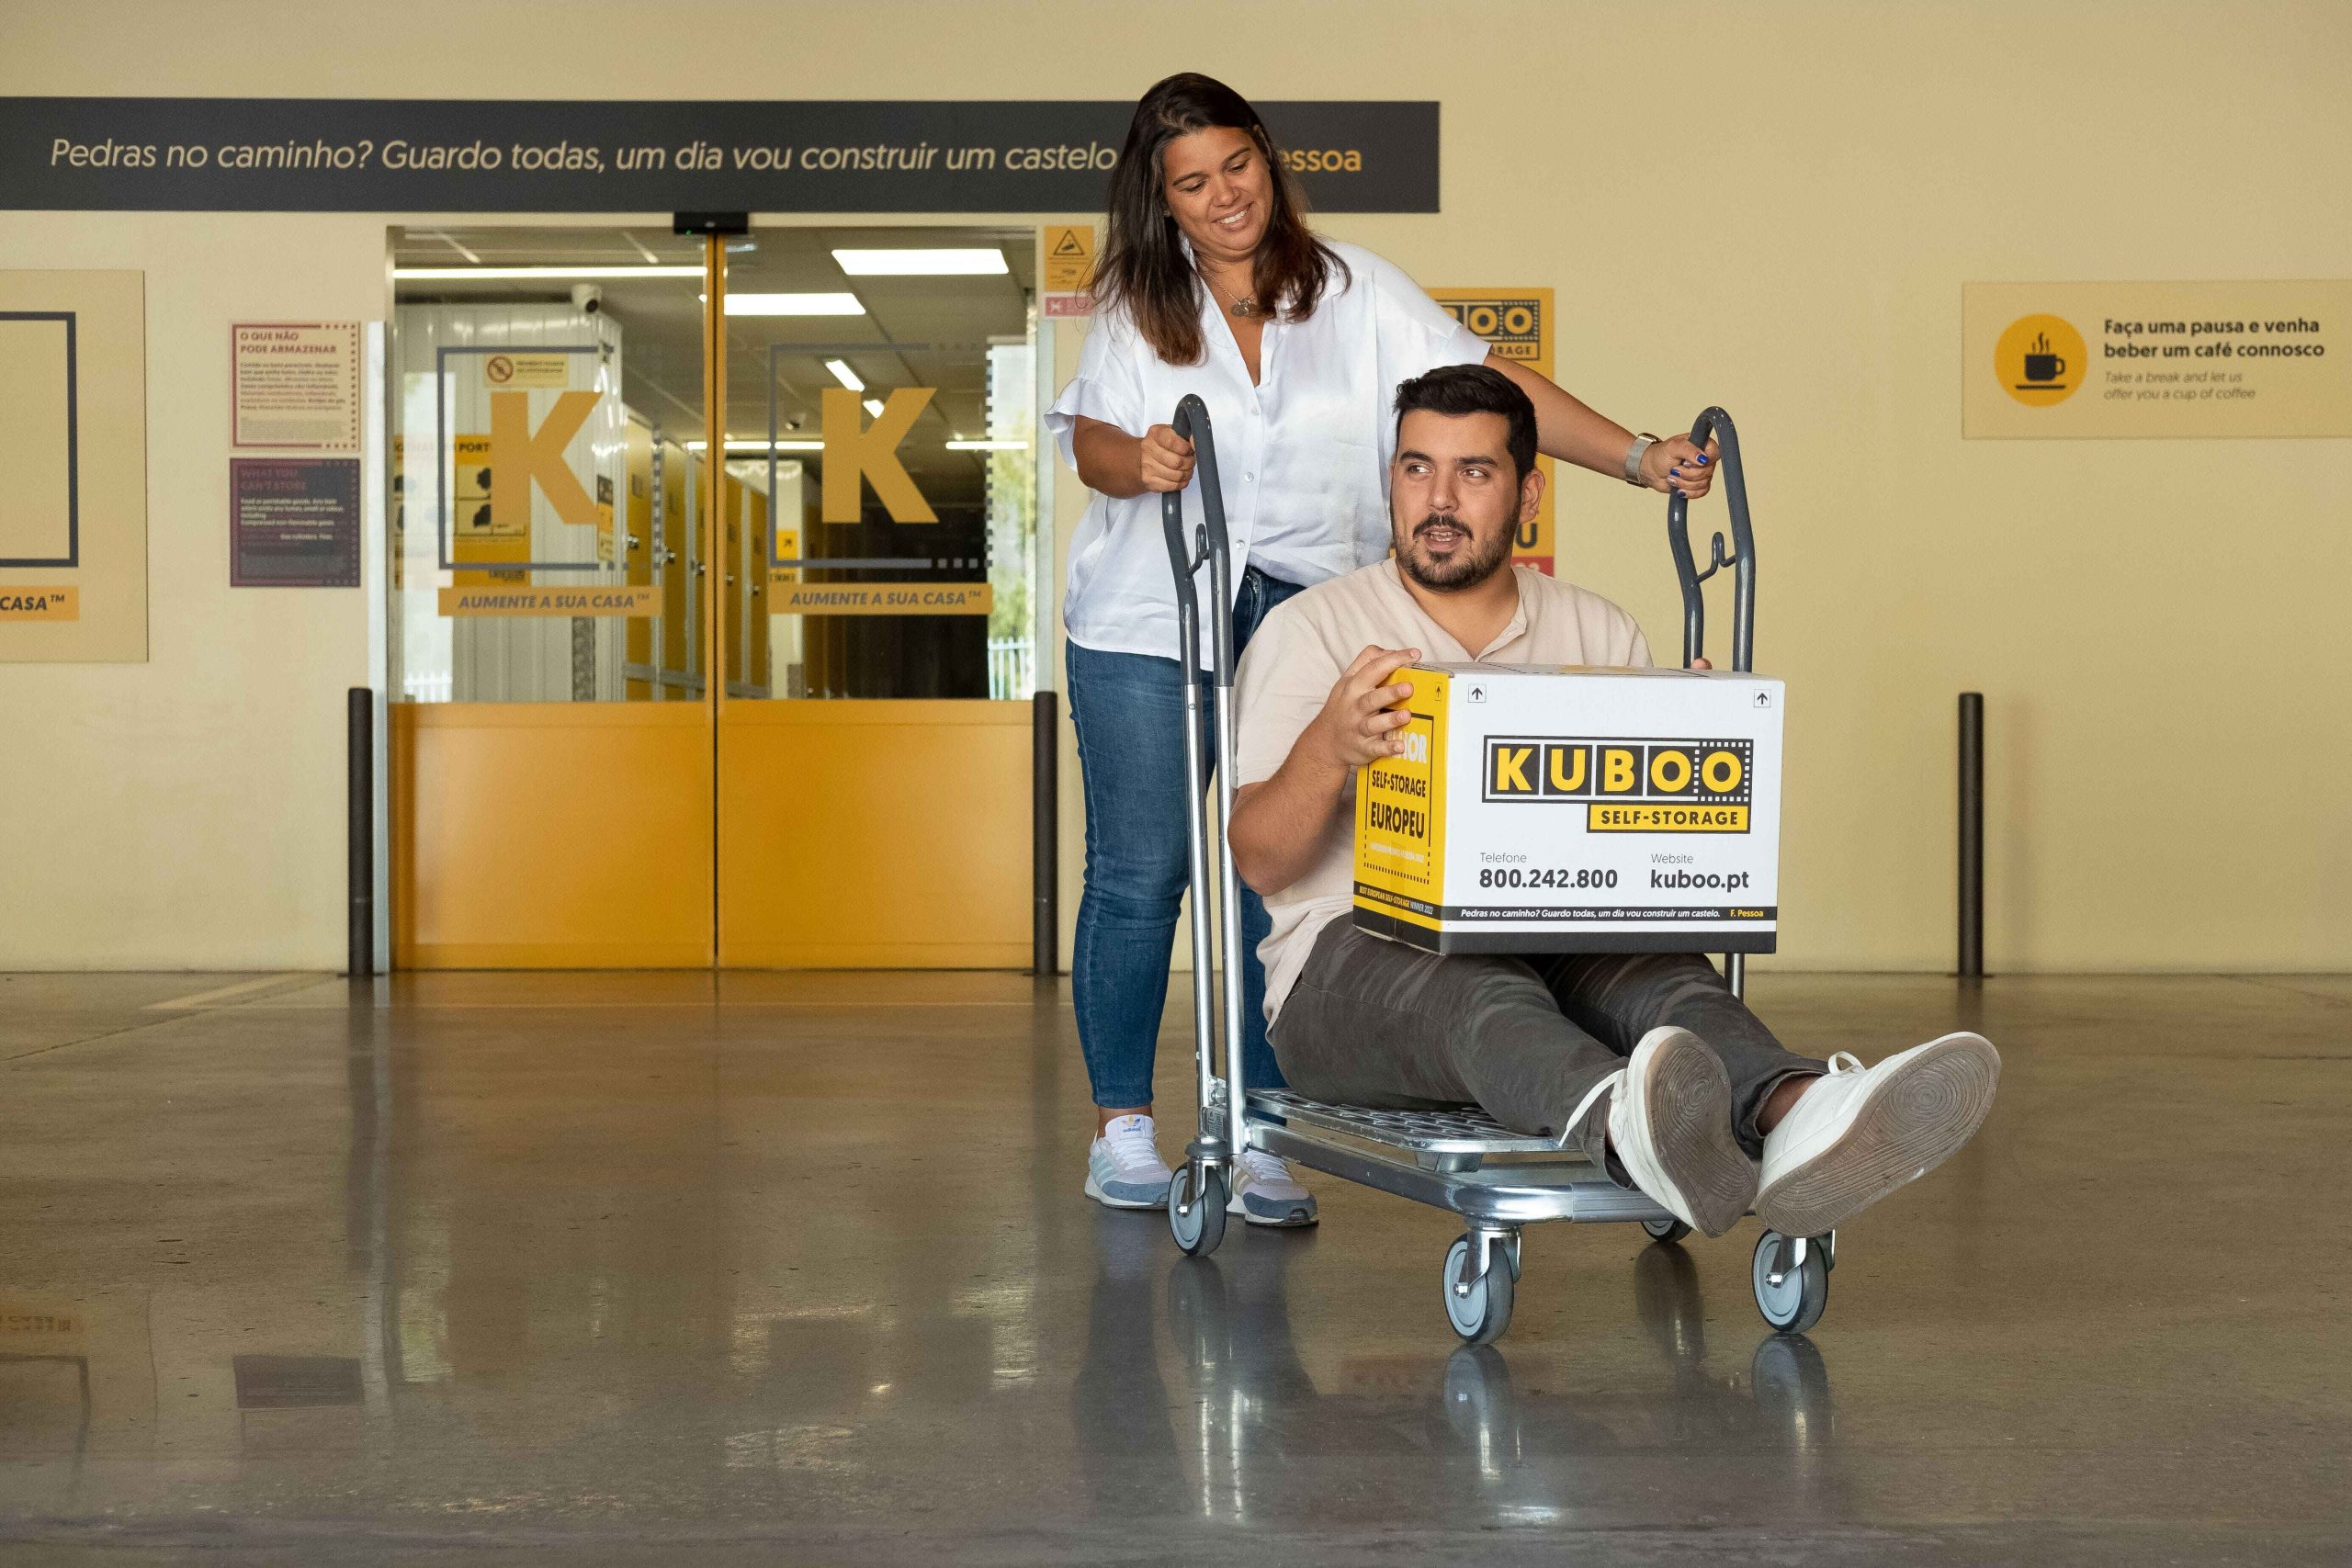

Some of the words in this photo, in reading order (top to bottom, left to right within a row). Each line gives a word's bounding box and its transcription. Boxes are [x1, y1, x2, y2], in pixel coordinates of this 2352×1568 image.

[51, 138, 157, 168] Pedras
[166, 145, 209, 169] no
[217, 140, 374, 170] caminho?
[381, 140, 503, 171] Guardo
[511, 141, 605, 175] todas,
[616, 145, 665, 171] um
[674, 141, 724, 171] dia
[733, 145, 791, 171] vou
[800, 141, 938, 171] construir
[945, 145, 996, 171] um
[1005, 142, 1117, 171] castelo
[2104, 320, 2143, 338] Faça
[2148, 321, 2186, 334] uma
[2190, 321, 2245, 337] pausa
[2249, 321, 2260, 333] e
[2265, 317, 2320, 333] venha
[240, 332, 249, 341] O
[251, 332, 273, 342] QUE
[2104, 342, 2157, 358] beber
[2163, 344, 2190, 358] um
[2195, 342, 2233, 357] café
[2237, 344, 2324, 357] connosco
[2105, 370, 2132, 383] Take
[2134, 373, 2143, 383] a
[2145, 370, 2179, 383] break
[2183, 370, 2209, 383] and
[2211, 370, 2226, 383] let
[2229, 372, 2243, 383] us
[2103, 388, 2133, 400] offer
[2135, 389, 2159, 402] you
[2162, 389, 2170, 400] a
[2173, 389, 2197, 402] cup
[2199, 387, 2214, 400] of
[2215, 388, 2256, 400] coffee
[490, 390, 604, 525] K
[821, 387, 939, 523] K
[458, 595, 536, 609] AUMENTE
[539, 595, 551, 608] A
[555, 595, 588, 608] SUA
[790, 592, 868, 606] AUMENTE
[871, 592, 882, 605] A
[887, 592, 919, 605] SUA
[1496, 747, 1743, 794] KUBOO
[1372, 770, 1427, 797] SELF-STORAGE
[1370, 801, 1425, 839] EUROPEU
[1600, 810, 1739, 825] SELF-STORAGE
[1480, 852, 1527, 863] Telefone
[1650, 853, 1694, 864] Website
[1479, 868, 1618, 888] 800.242.800
[1650, 869, 1749, 893] kuboo.pt
[1424, 904, 1434, 915] 2022
[1461, 908, 1488, 918] Pedras
[1501, 908, 1540, 918] caminho?
[1542, 908, 1571, 918] Guardo
[1573, 909, 1597, 919] todas,
[1612, 909, 1625, 918] dia
[1643, 909, 1676, 918] construir
[1691, 909, 1721, 918] castelo.
[1730, 909, 1736, 918] F.
[1737, 909, 1764, 918] Pessoa
